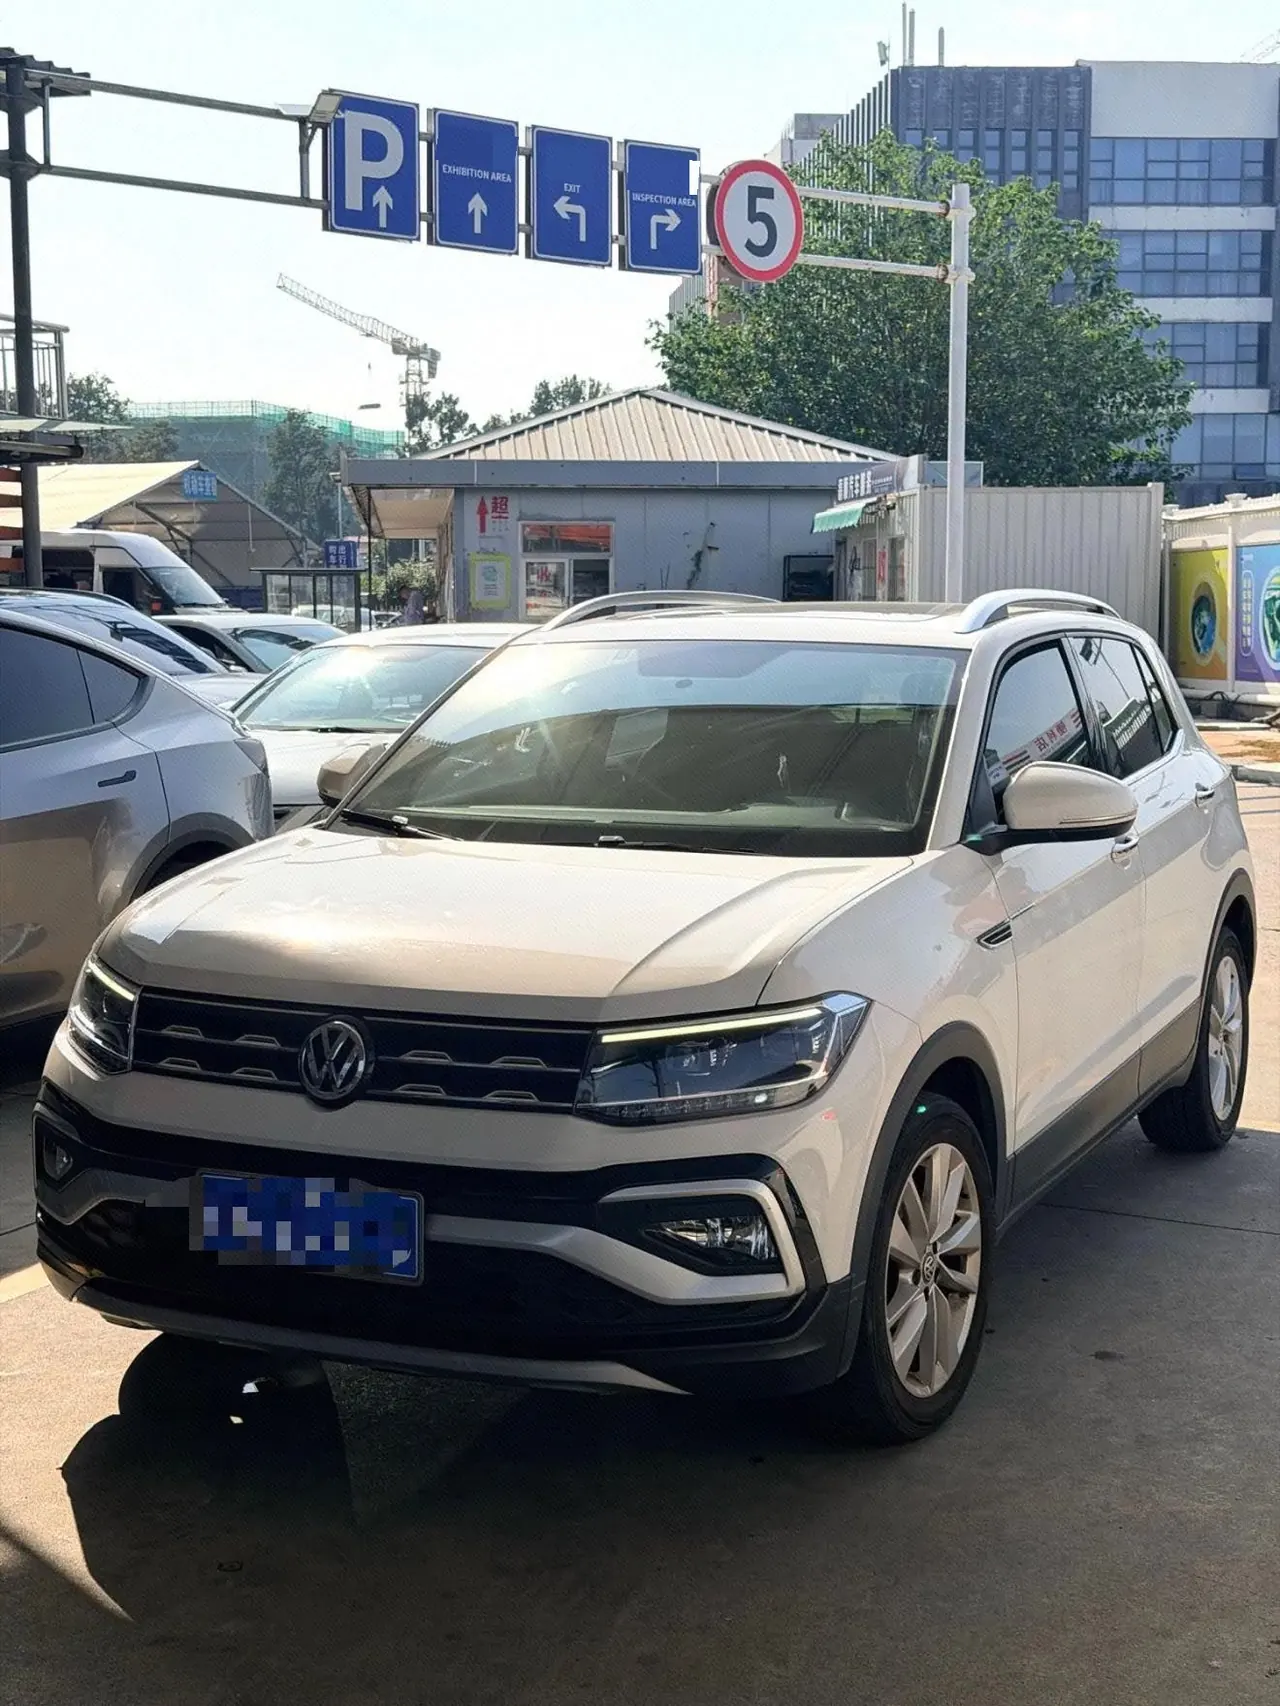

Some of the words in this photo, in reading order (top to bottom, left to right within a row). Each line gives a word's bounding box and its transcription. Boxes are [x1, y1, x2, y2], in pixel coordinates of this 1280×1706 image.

[345, 110, 404, 211] P
[442, 164, 489, 180] EXHIBITION
[490, 172, 512, 183] AREA
[563, 183, 581, 194] EXIT
[631, 192, 677, 206] INSPECTION
[678, 197, 697, 208] AREA
[744, 185, 778, 258] 5
[491, 496, 509, 519] 超
